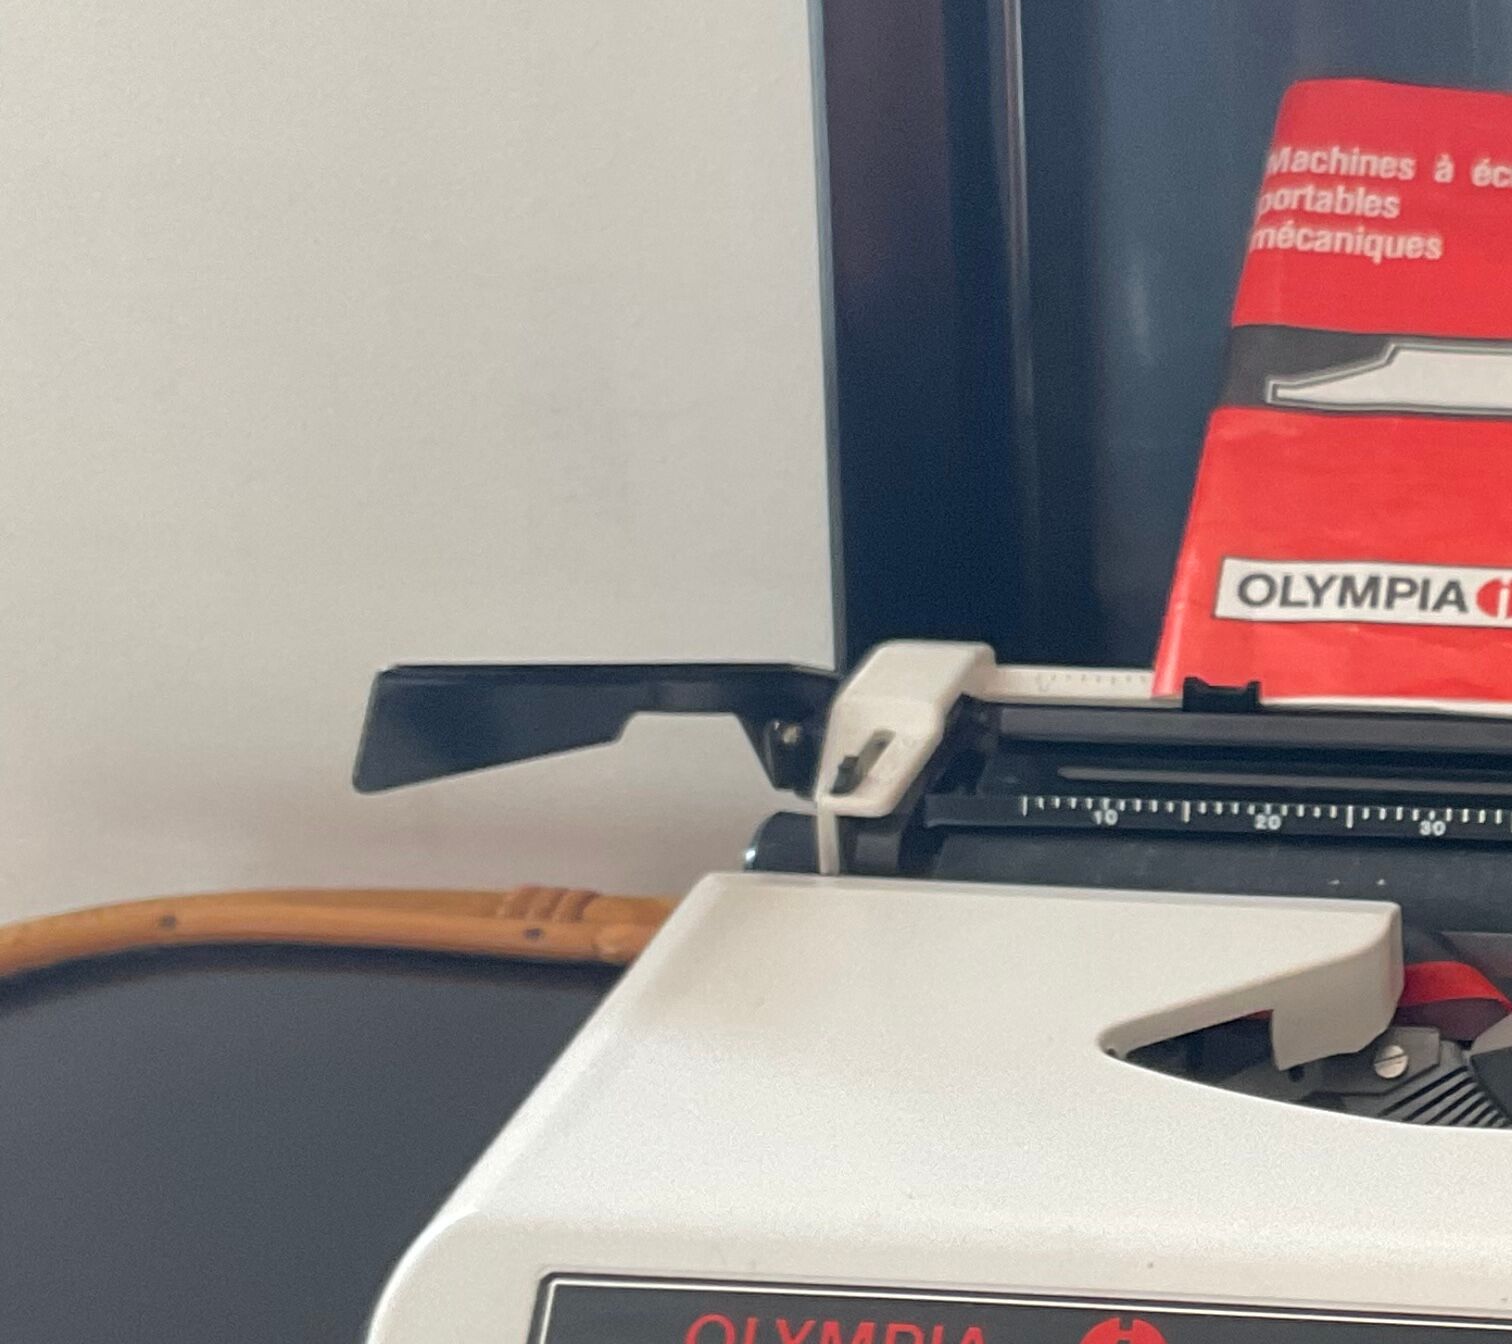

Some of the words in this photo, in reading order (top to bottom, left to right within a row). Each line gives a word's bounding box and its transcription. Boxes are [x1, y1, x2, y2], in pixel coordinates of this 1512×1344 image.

[1266, 146, 1415, 181] Machines
[1433, 152, 1454, 183] à
[1251, 220, 1443, 264] mécaniques
[1237, 573, 1470, 613] OLYMPIA
[1093, 808, 1119, 826] 10
[1254, 813, 1282, 831] 20
[1418, 819, 1447, 837] 30
